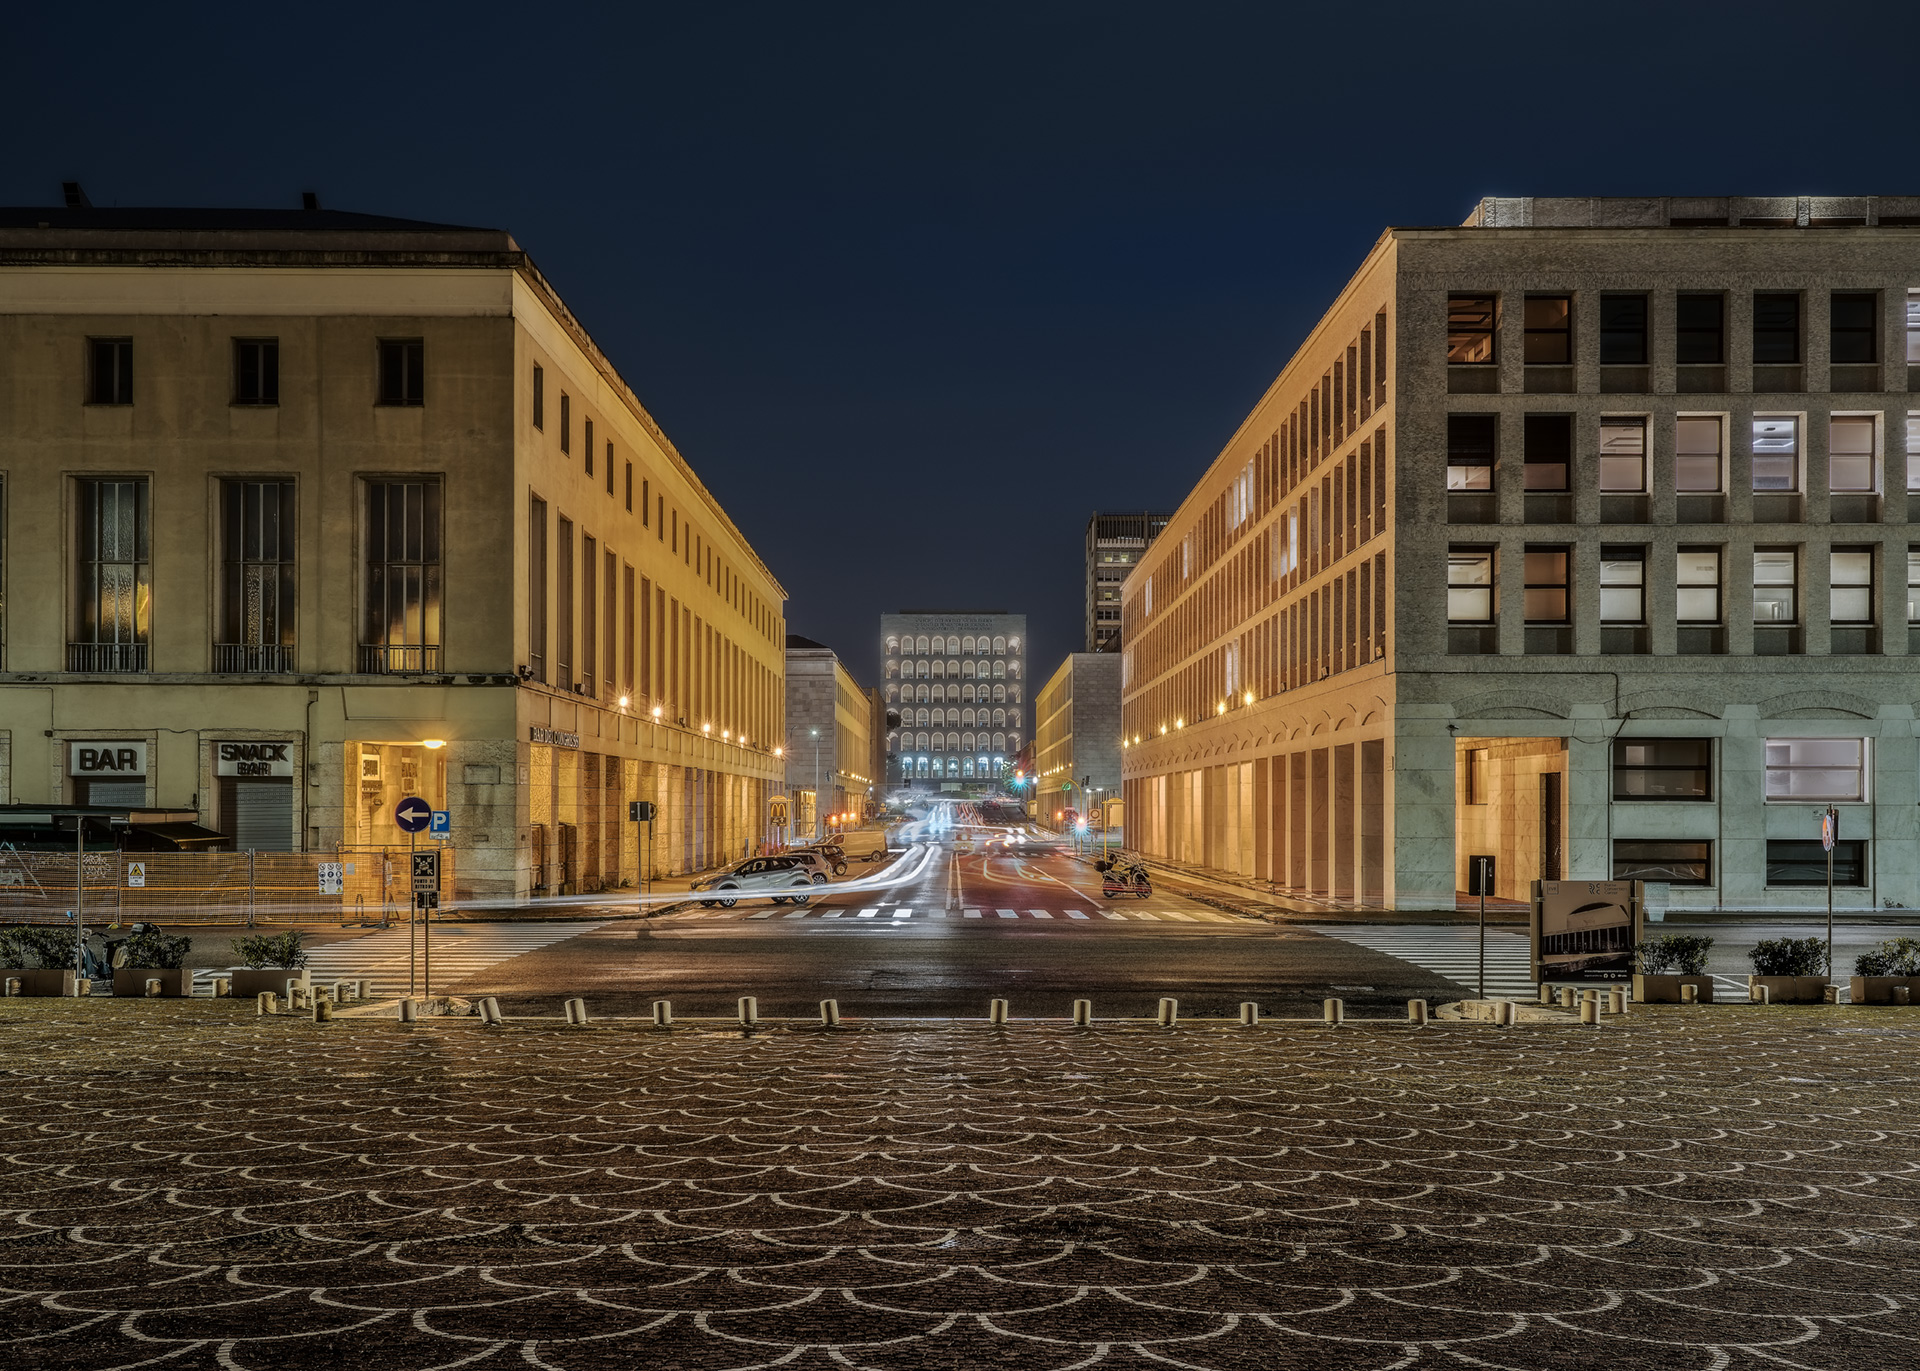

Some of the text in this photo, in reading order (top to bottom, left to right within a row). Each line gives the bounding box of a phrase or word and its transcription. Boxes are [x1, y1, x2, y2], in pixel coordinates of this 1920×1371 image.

[534, 727, 544, 742] BAR
[79, 749, 137, 771] BAR
[221, 744, 288, 762] SNACK
[237, 762, 271, 776] BAR
[433, 813, 447, 830] P
